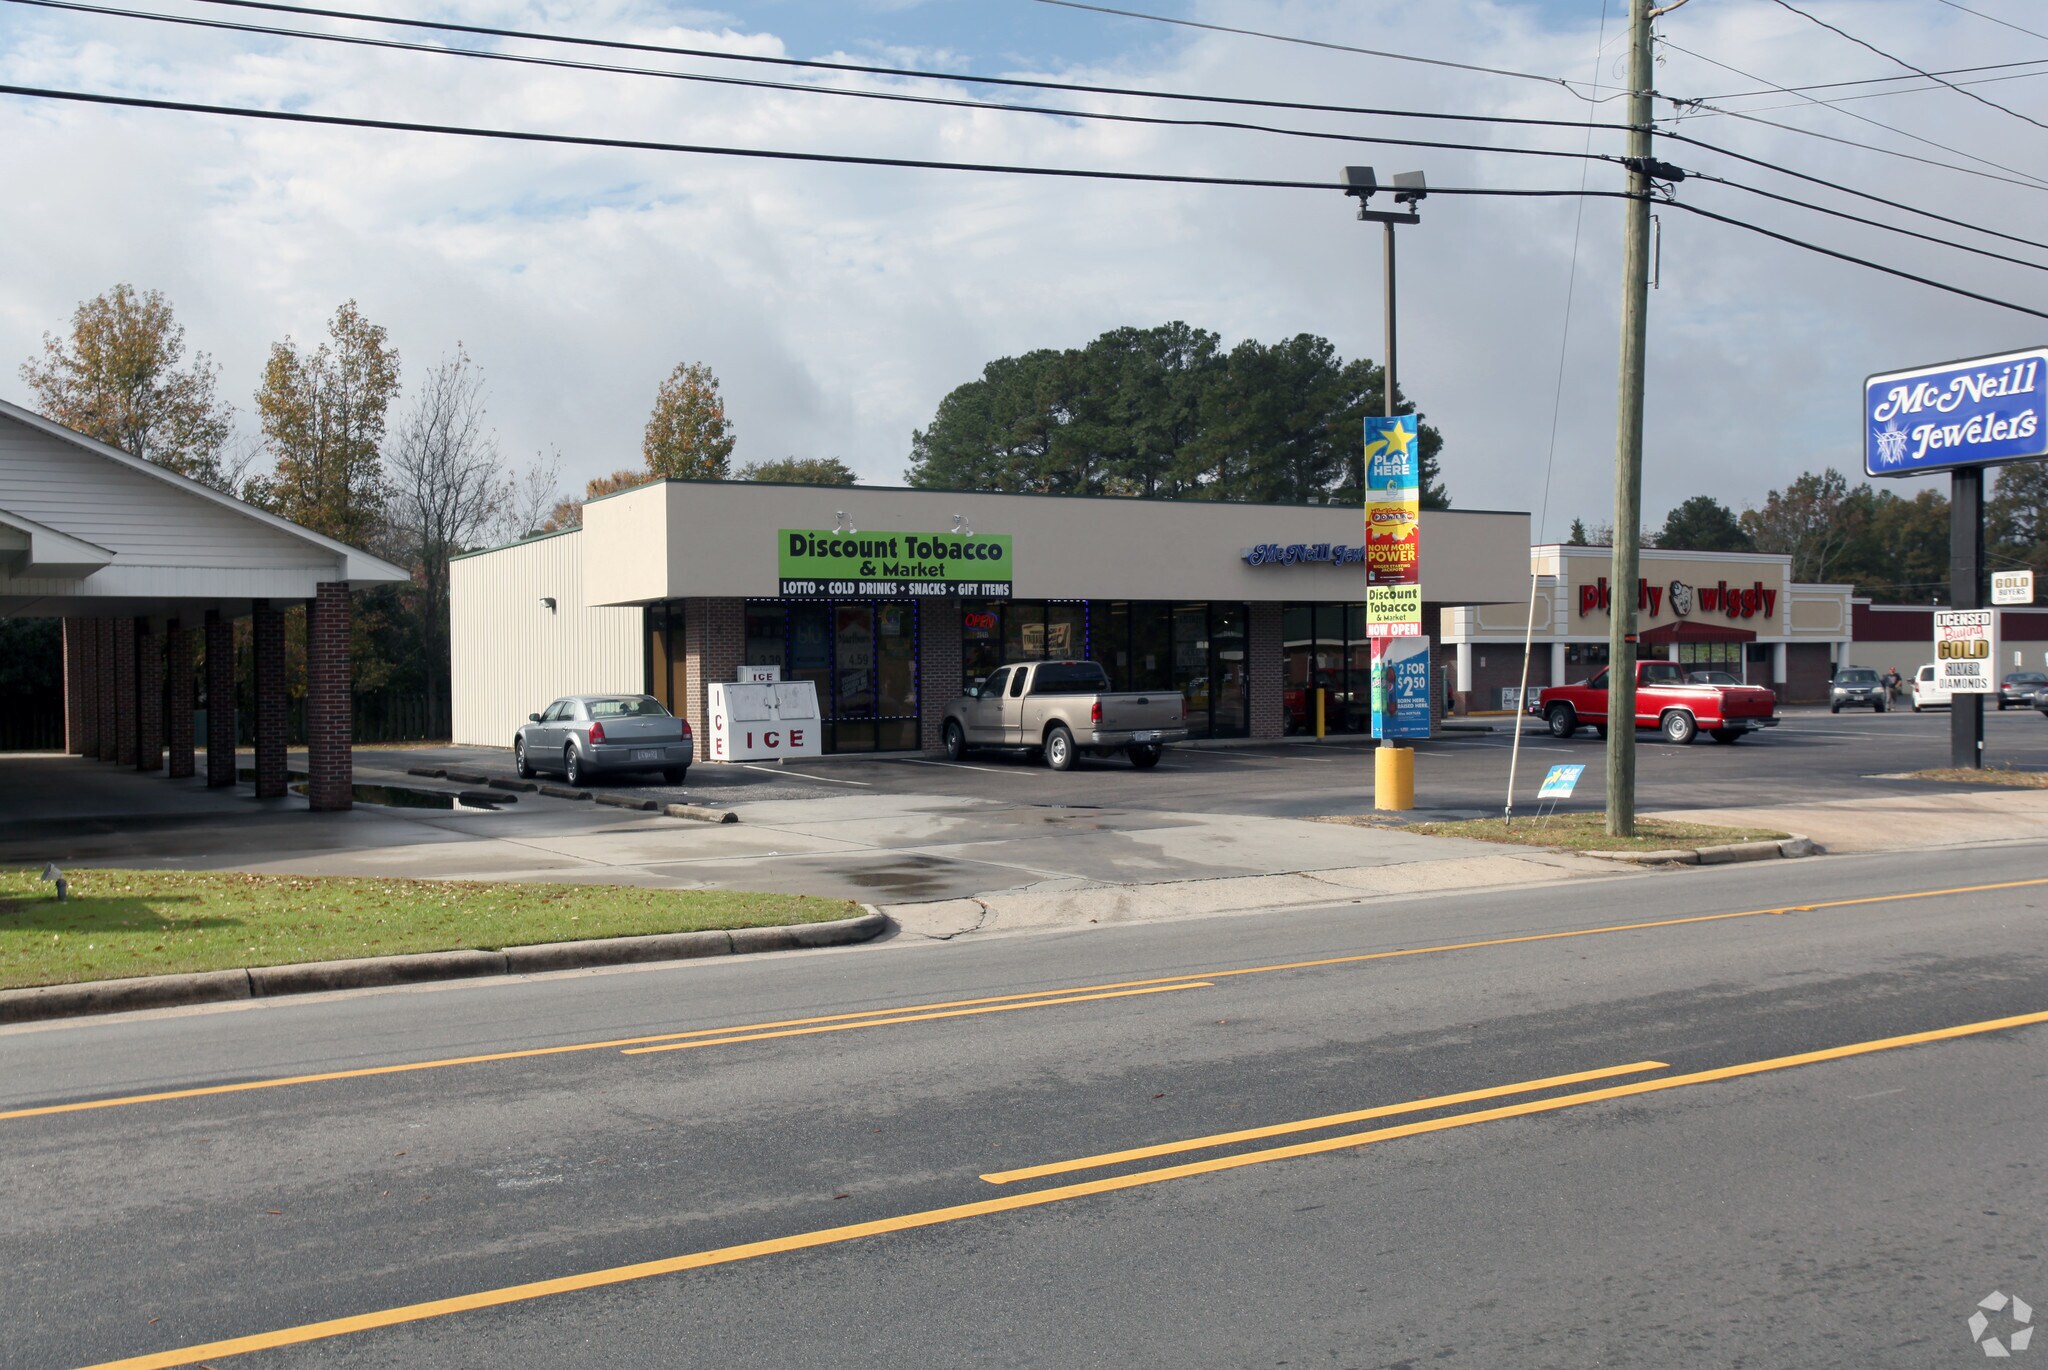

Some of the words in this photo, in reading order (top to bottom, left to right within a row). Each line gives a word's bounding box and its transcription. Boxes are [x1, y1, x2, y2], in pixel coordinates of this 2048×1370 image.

[1873, 361, 2038, 422] McNeill
[1911, 409, 2038, 459] Jewelers
[1374, 453, 1409, 466] PLAY
[1373, 464, 1410, 476] HERE
[789, 533, 898, 559] Discount
[904, 536, 1003, 561] Tobacco
[1368, 544, 1389, 552] NOW
[1391, 543, 1415, 551] MORE
[1368, 551, 1416, 562] POWER
[859, 560, 877, 576] &
[883, 561, 945, 577] Market
[783, 581, 816, 595] LOTTO
[828, 581, 855, 595] COLD
[858, 582, 897, 596] DRINKS
[908, 582, 947, 596] SNACKS
[958, 583, 979, 596] GIFT
[981, 583, 1010, 597] ITEMS
[1995, 577, 2029, 589] GOLD
[1369, 588, 1418, 600] Discount
[1579, 577, 1663, 618] pily
[1698, 580, 1777, 619] wiggly
[1369, 602, 1417, 613] Tobacco
[965, 613, 996, 629] OPEN
[1383, 613, 1406, 621] Market
[1937, 612, 1991, 627] LICENSED
[1368, 624, 1388, 636] NOW
[1391, 623, 1418, 636] OPEN
[1943, 624, 1984, 641] Buying
[1938, 640, 1989, 660] GOLD
[1398, 664, 1404, 675] 2
[1406, 663, 1425, 674] FOR
[1945, 662, 1980, 677] SILVER
[753, 673, 773, 681] ICE
[1939, 678, 1987, 689] DIAMONDS
[747, 729, 804, 749] ICE
